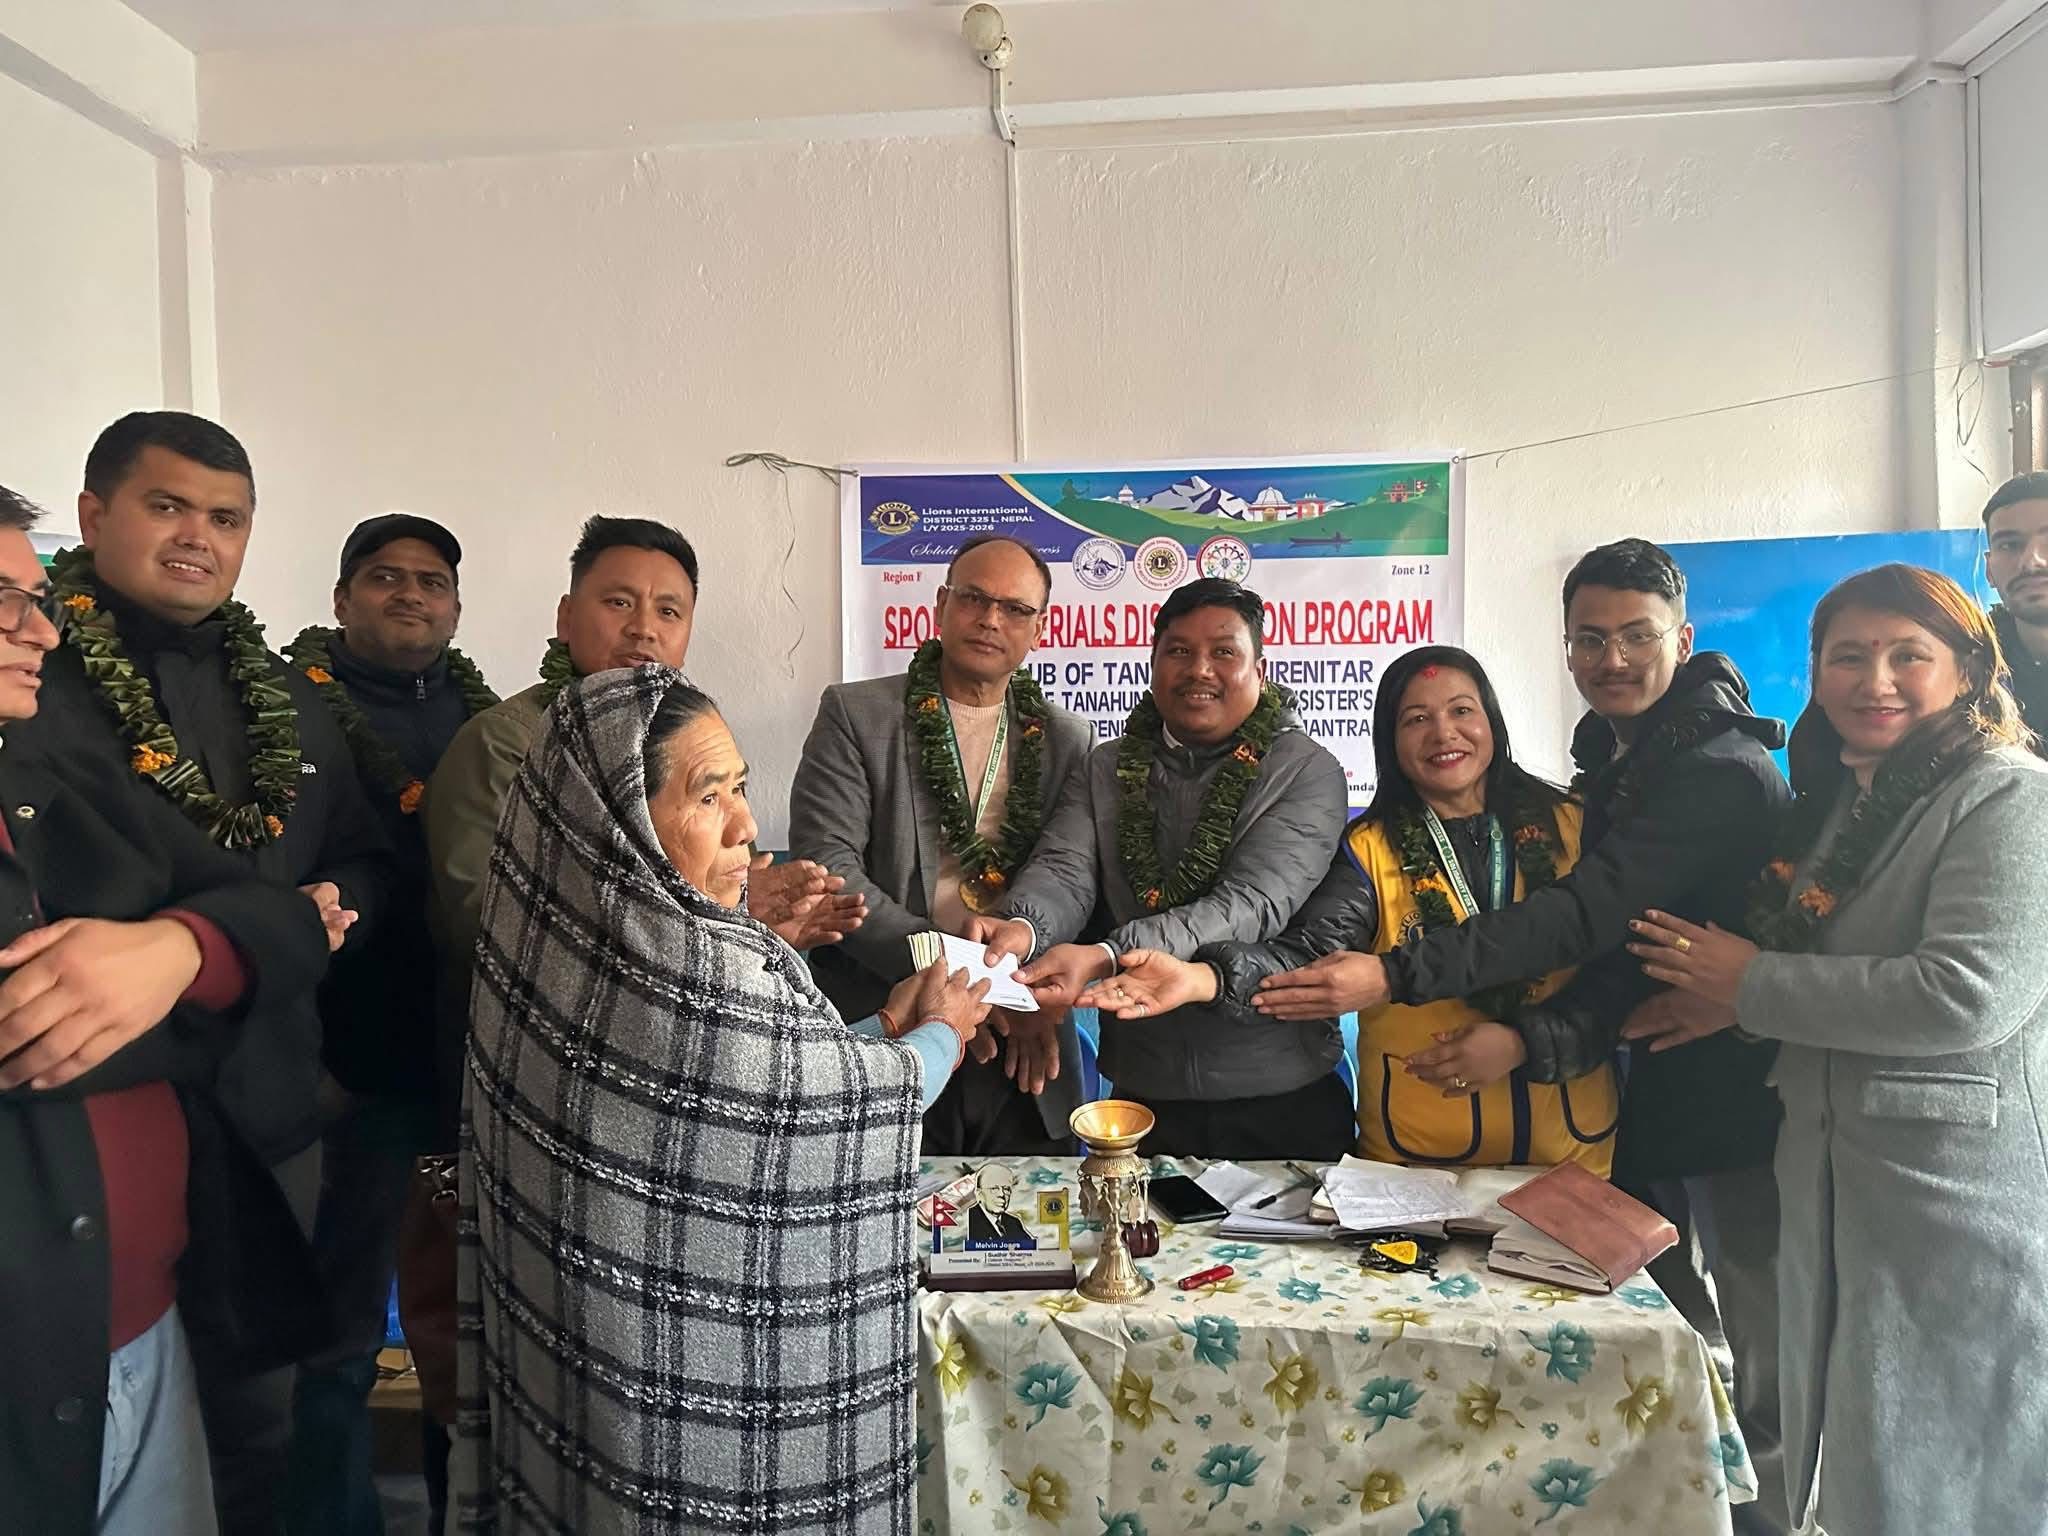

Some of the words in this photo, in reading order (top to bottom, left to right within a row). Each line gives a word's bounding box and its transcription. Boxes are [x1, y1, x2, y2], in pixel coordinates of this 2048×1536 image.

[955, 506, 1028, 515] International
[1001, 515, 1035, 523] NEPAL
[910, 543, 959, 557] Solida
[883, 571, 914, 584] Region
[1391, 564, 1415, 575] Zone
[1419, 564, 1430, 575] 12
[1124, 603, 1161, 647] DIS
[1262, 600, 1296, 646] ON
[1304, 599, 1434, 645] PROGRAM
[1065, 662, 1093, 685] OF
[1103, 662, 1149, 685] TAN
[1270, 660, 1374, 684] IRENITAR
[1303, 719, 1371, 737] ANTRA
[975, 1241, 998, 1249] Melvin
